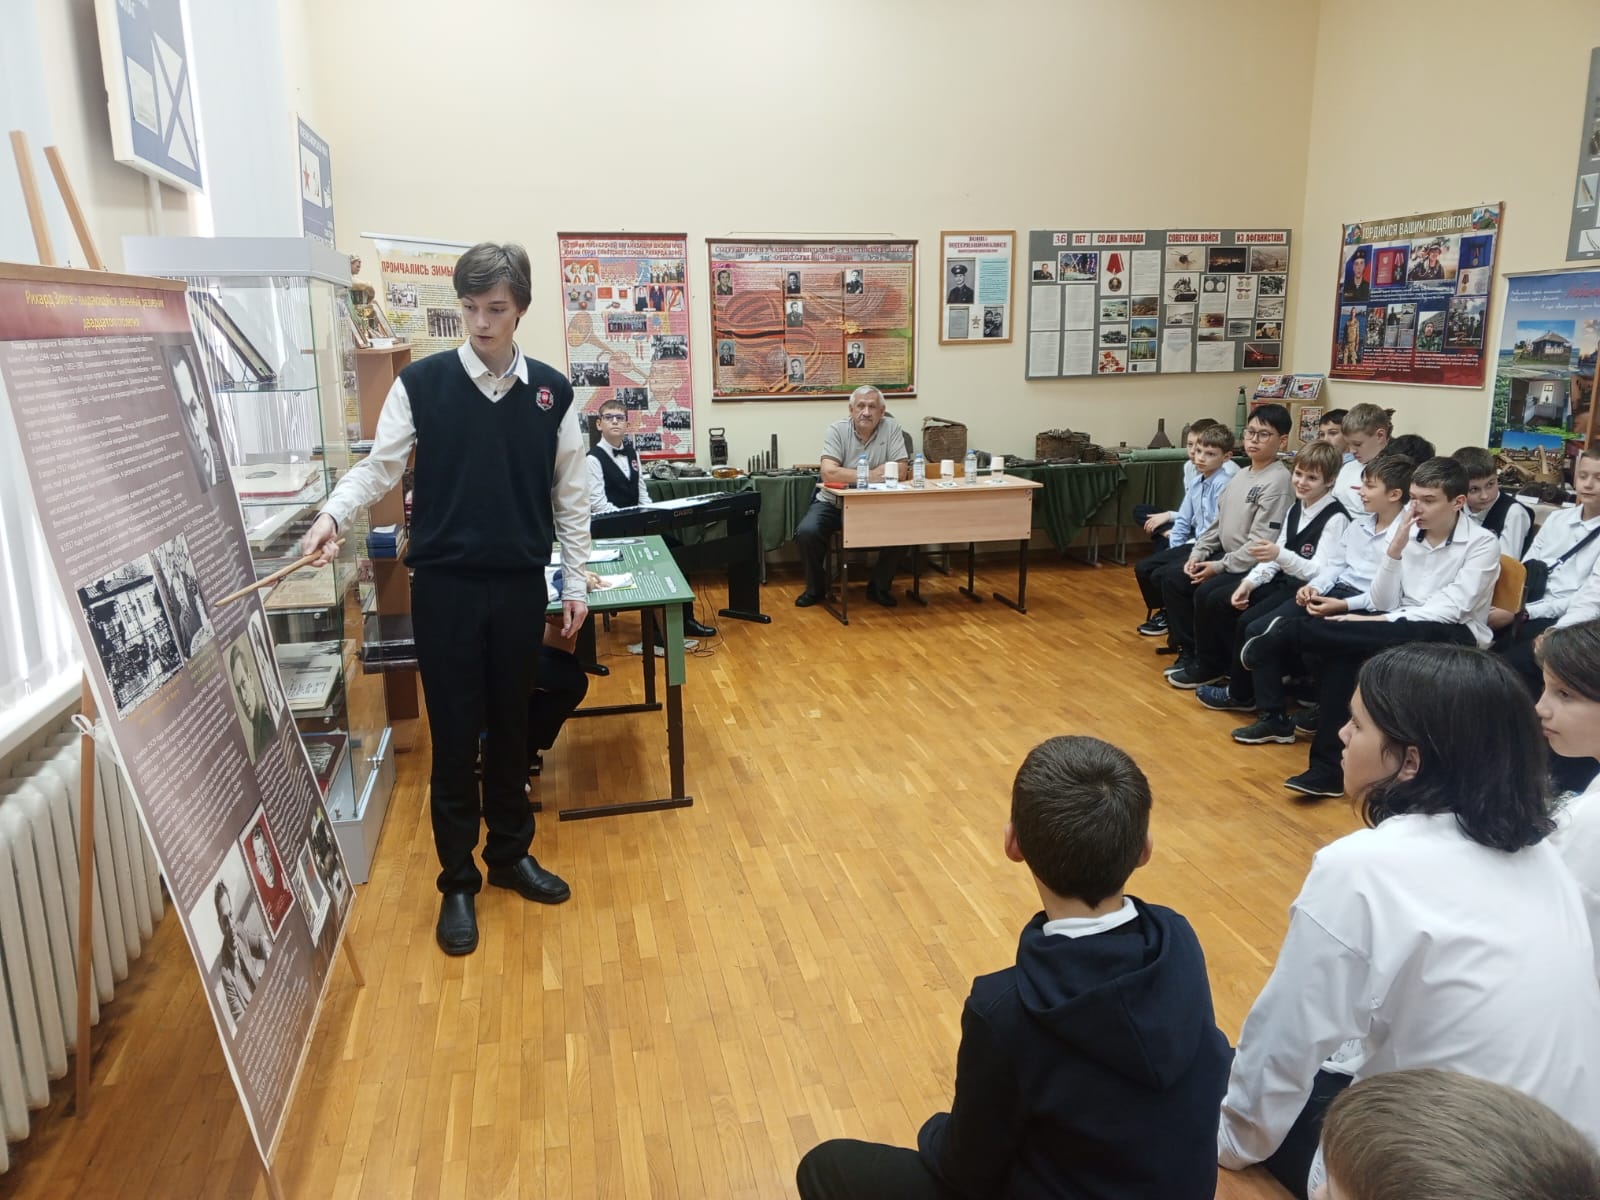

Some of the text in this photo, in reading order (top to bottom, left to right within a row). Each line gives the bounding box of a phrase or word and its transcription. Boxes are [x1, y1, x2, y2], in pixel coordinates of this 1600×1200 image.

[1362, 213, 1473, 240] ГОРДИМСЯ ВАШИМ ПОДВИГОМ!
[1246, 233, 1284, 242] АФГАНИСТАНА
[381, 261, 429, 275] ПРОМЧАЛИСЬ
[25, 290, 55, 307] Рихард
